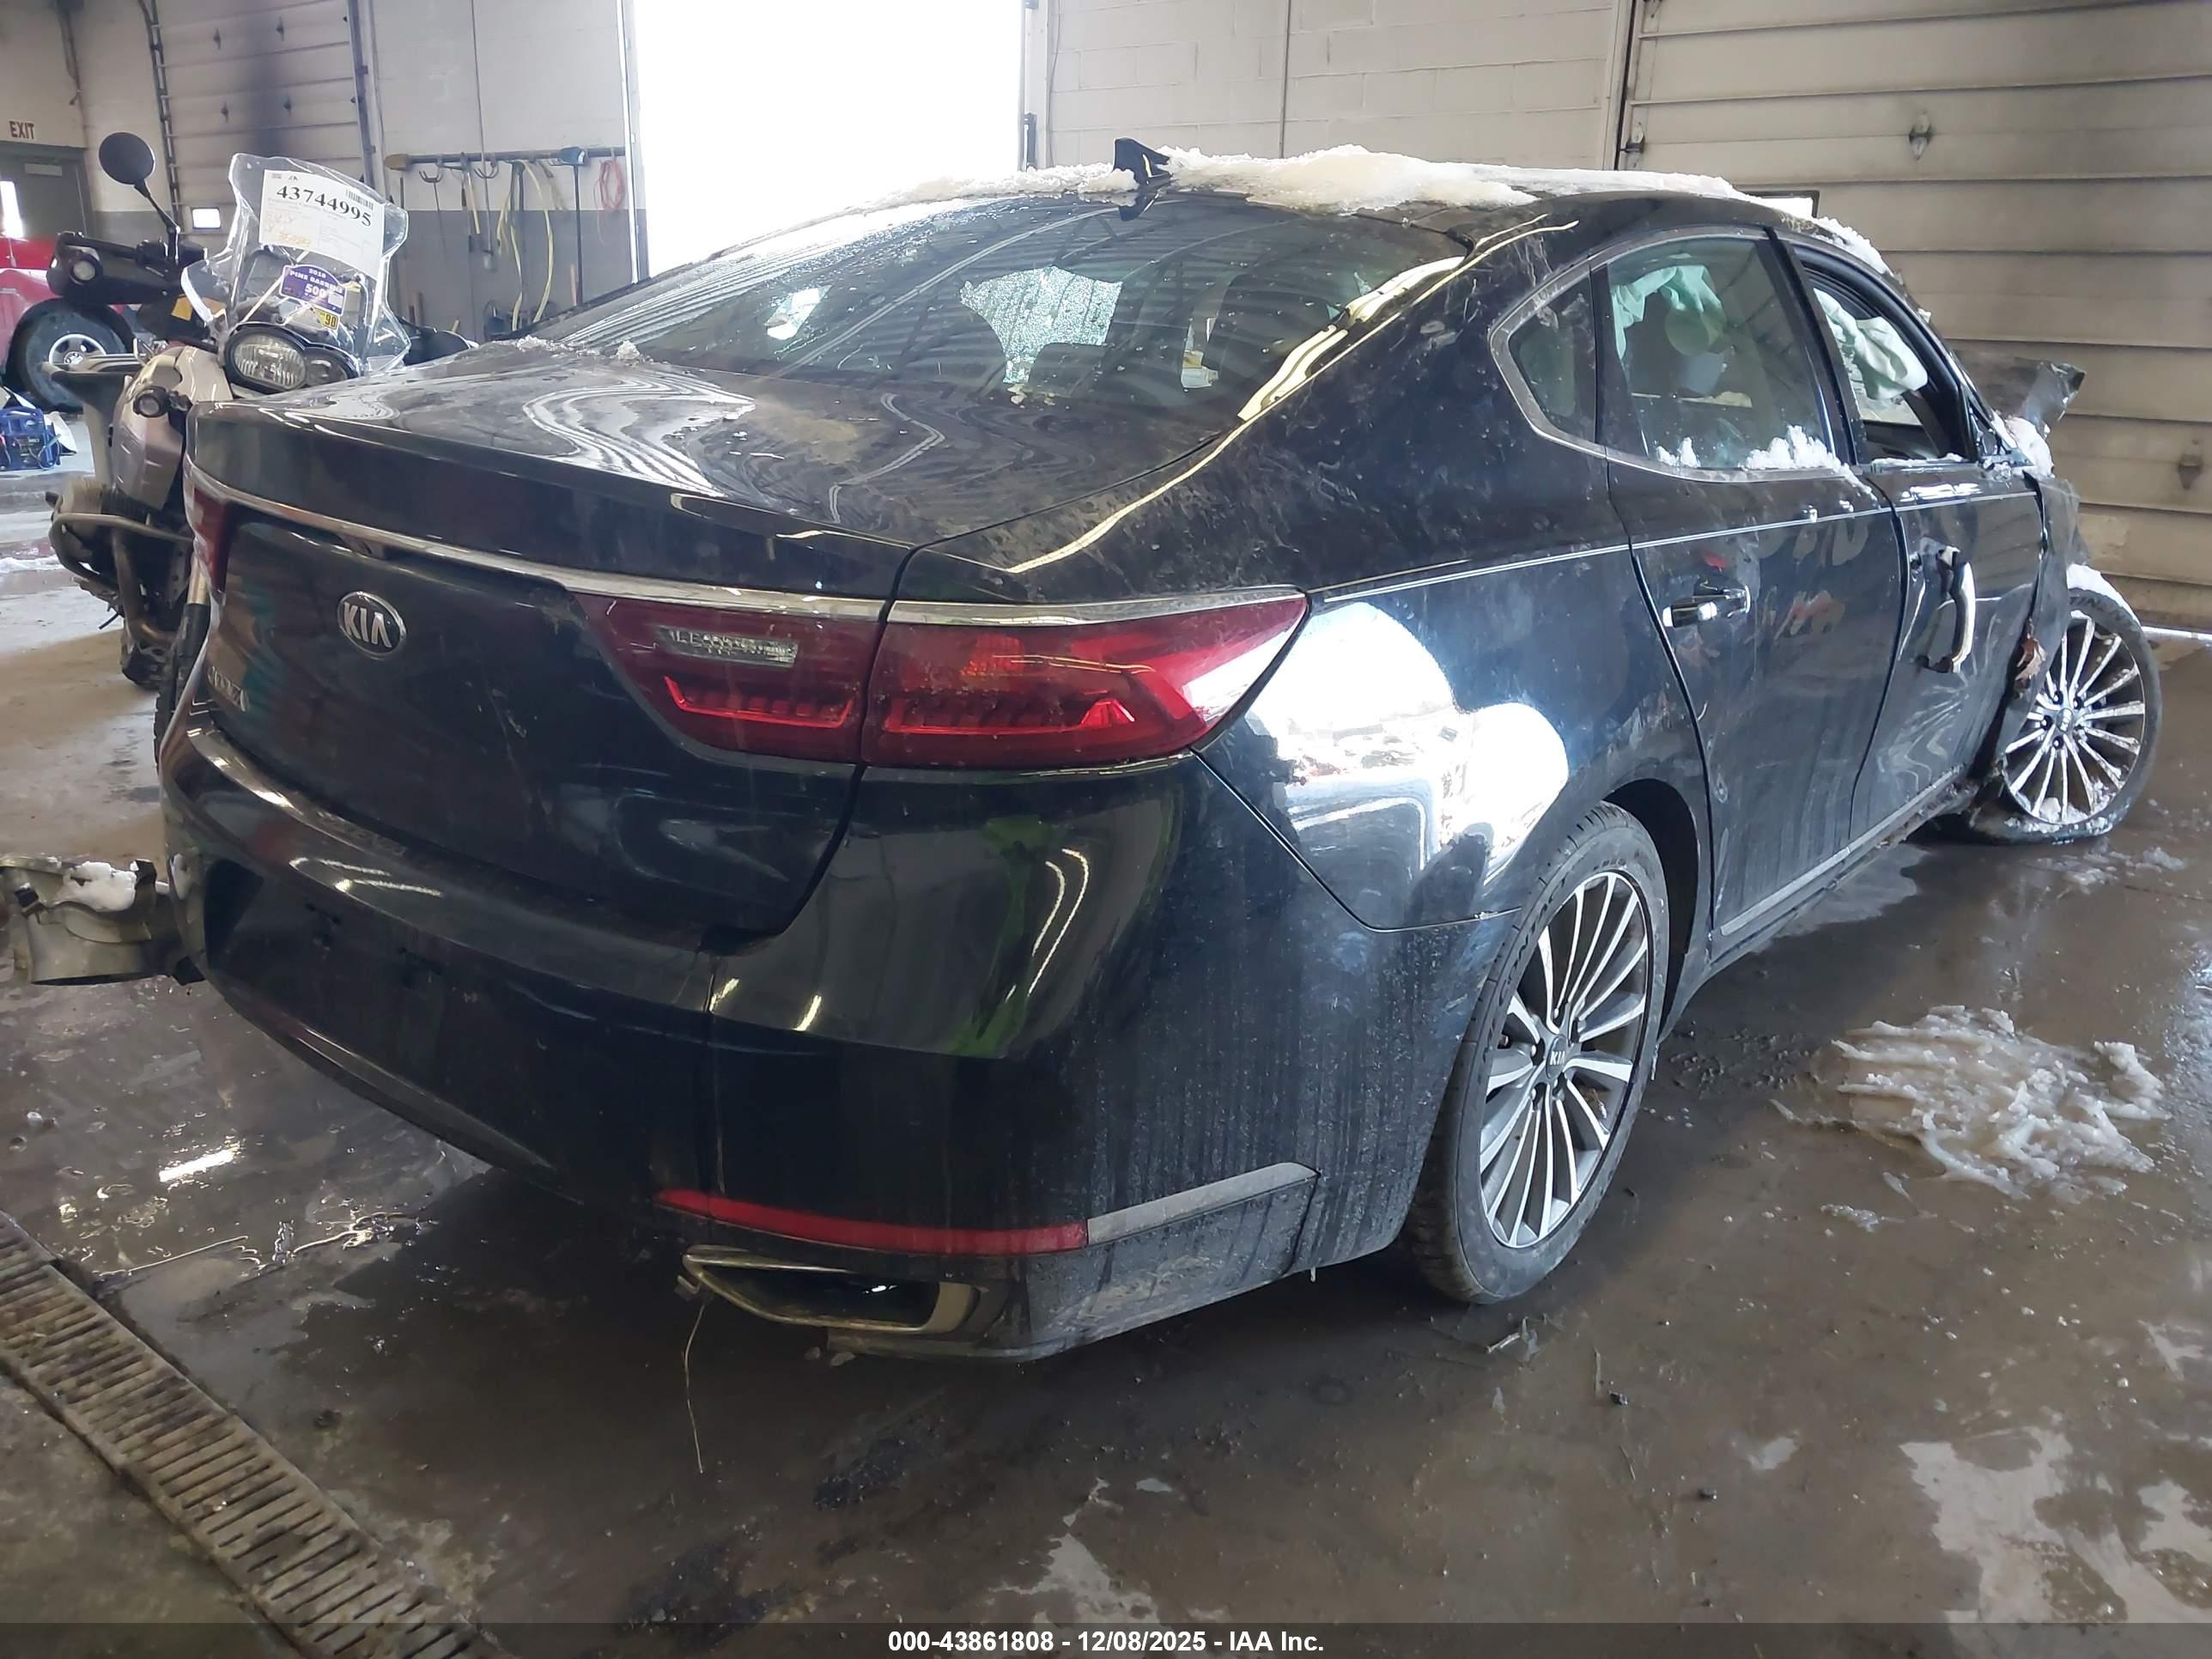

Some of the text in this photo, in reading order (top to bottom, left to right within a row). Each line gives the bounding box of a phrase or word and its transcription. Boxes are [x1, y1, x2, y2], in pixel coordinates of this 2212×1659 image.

[9, 121, 34, 139] EXIT
[276, 185, 371, 227] 43744995
[304, 283, 326, 298] 500
[344, 602, 392, 648] KIA
